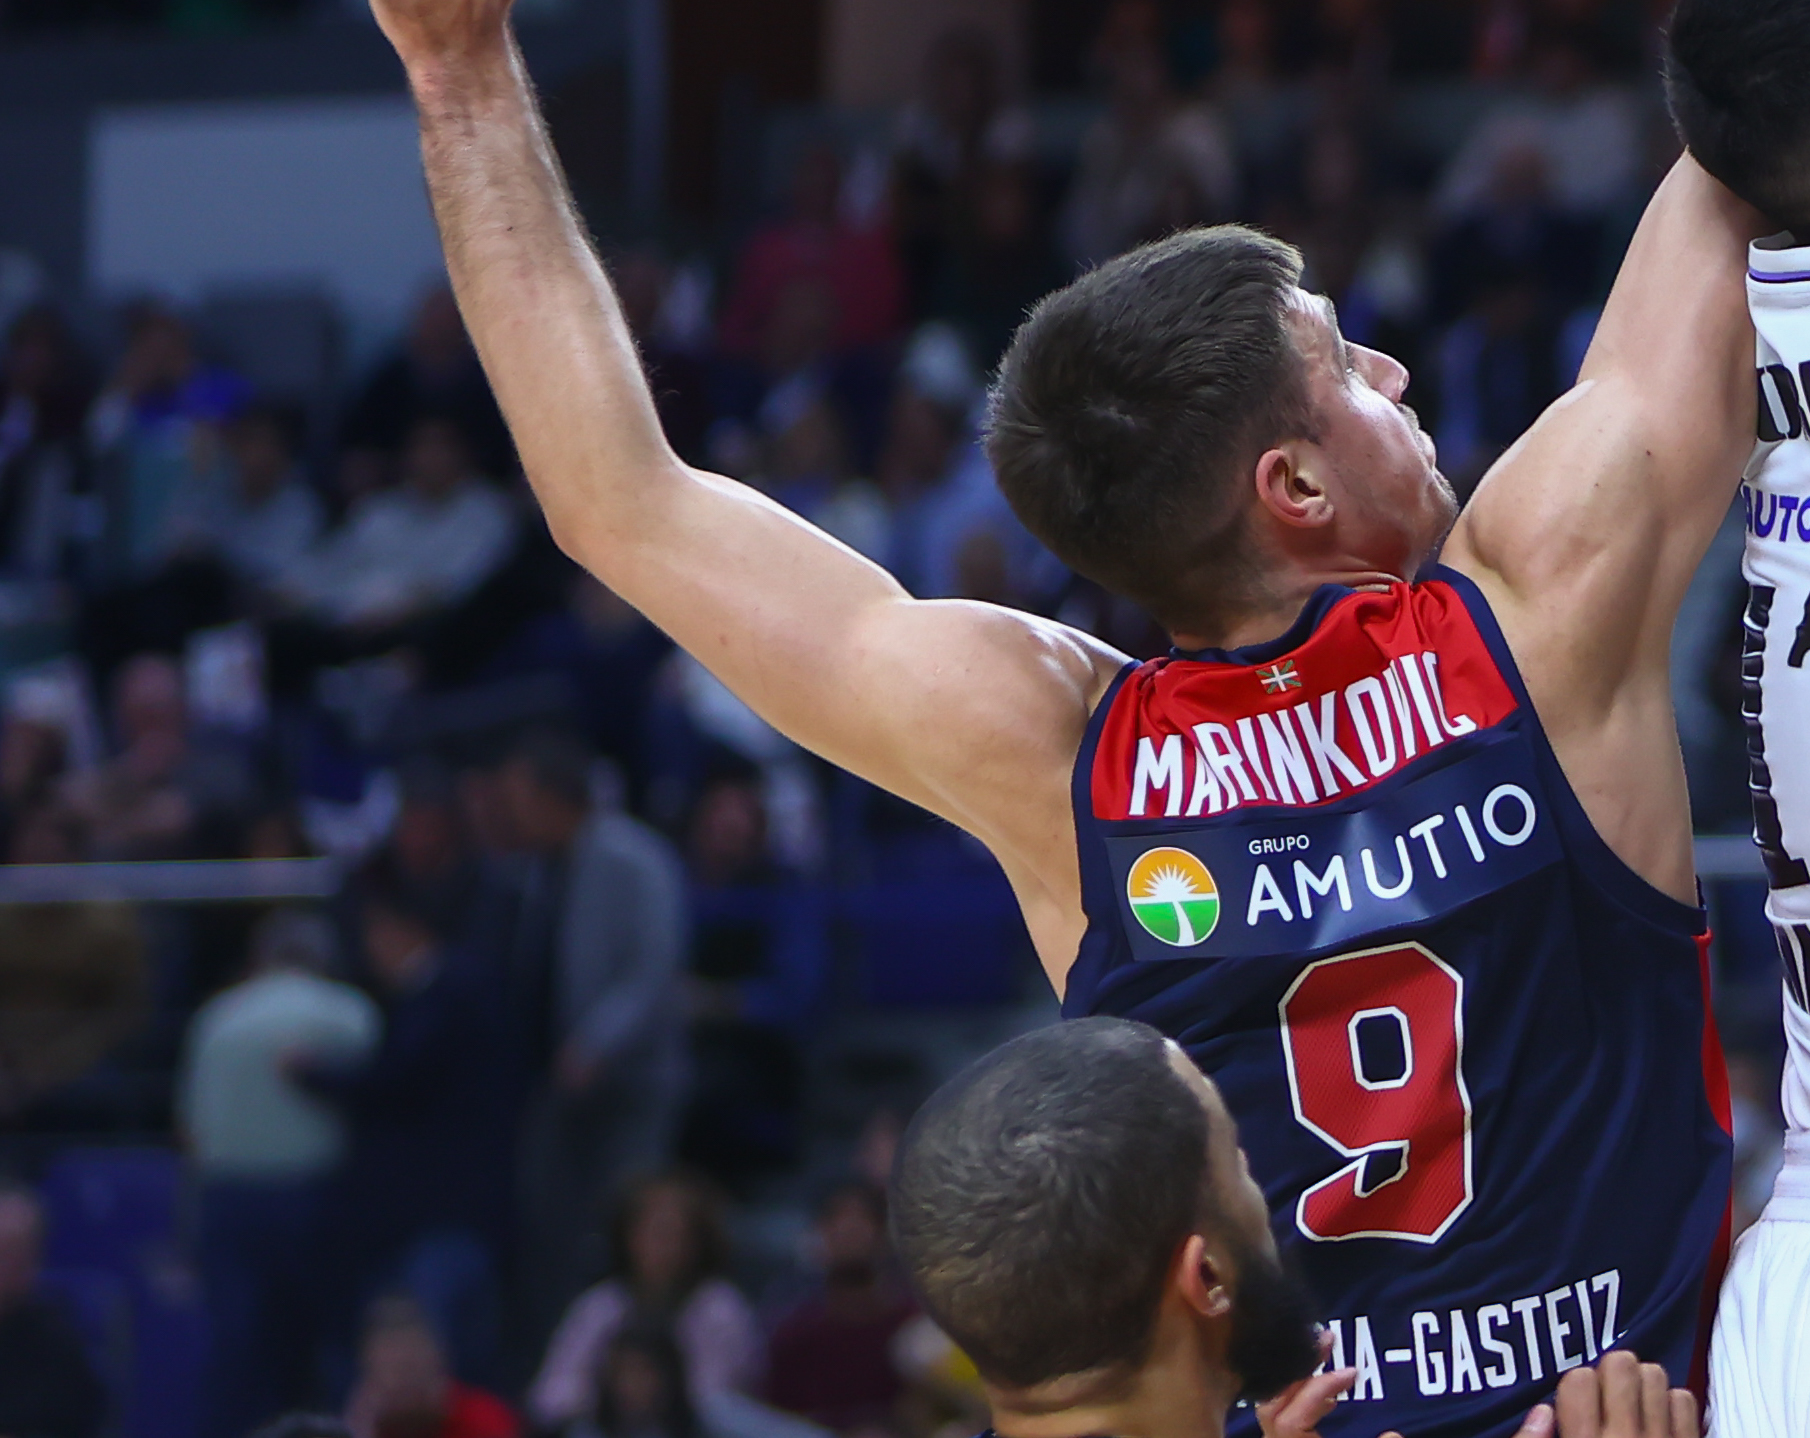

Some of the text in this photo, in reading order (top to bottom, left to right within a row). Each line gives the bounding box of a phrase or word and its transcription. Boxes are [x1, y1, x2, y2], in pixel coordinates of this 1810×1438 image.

[1246, 784, 1537, 926] AMUTIO
[1248, 835, 1310, 856] GRUPO
[1278, 940, 1474, 1245] 9
[1313, 1268, 1629, 1402] IA-GASTEIZ
